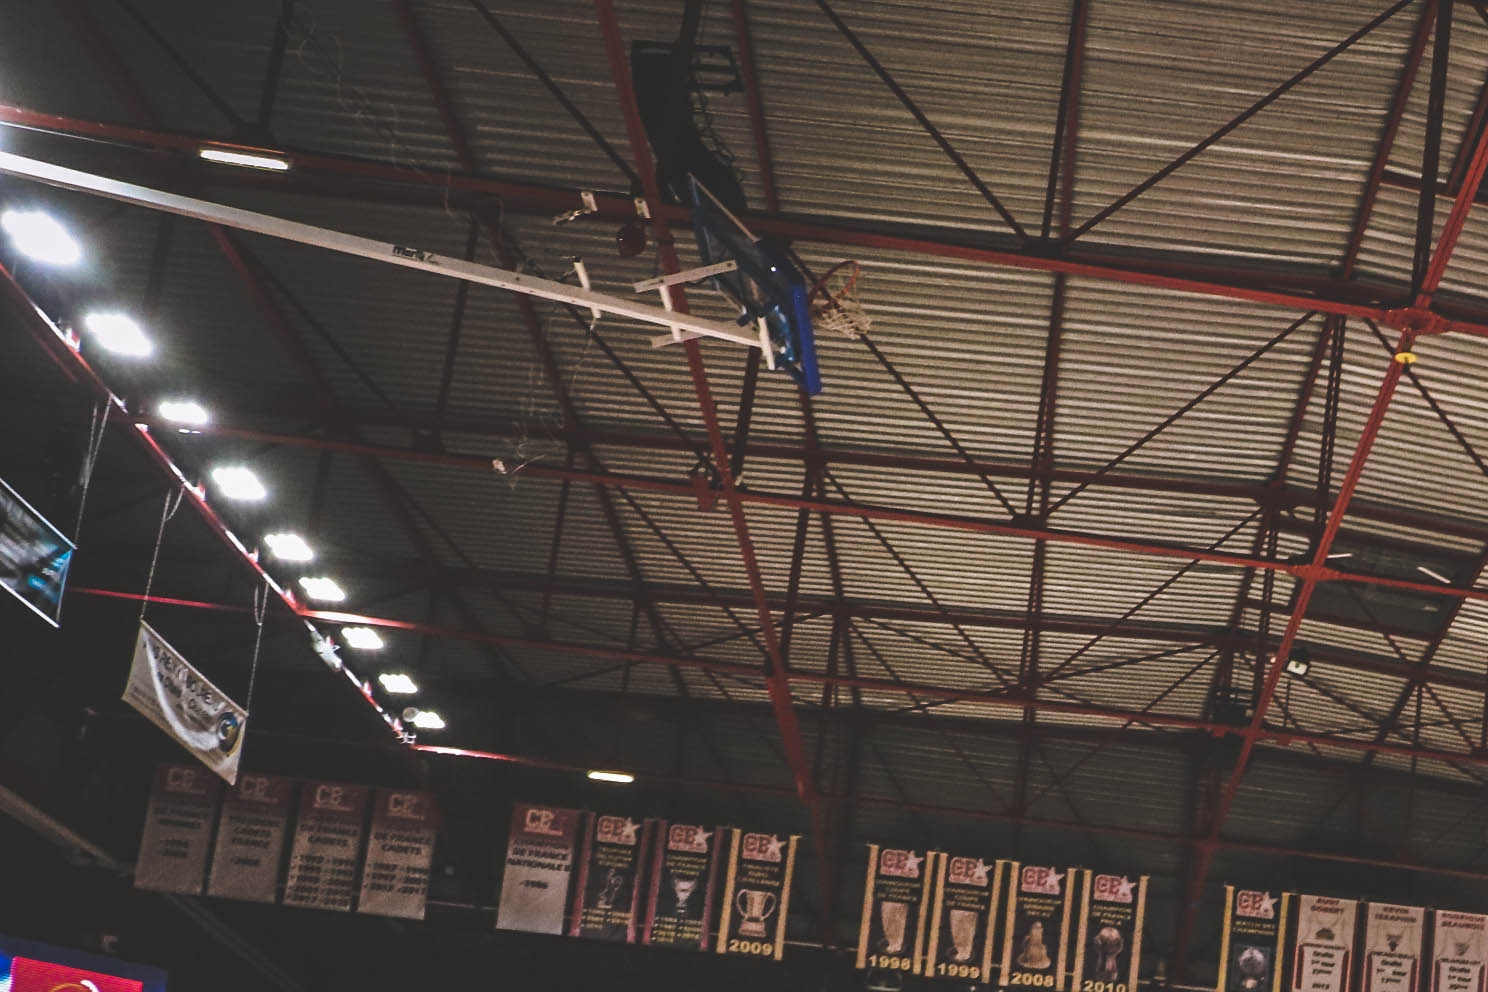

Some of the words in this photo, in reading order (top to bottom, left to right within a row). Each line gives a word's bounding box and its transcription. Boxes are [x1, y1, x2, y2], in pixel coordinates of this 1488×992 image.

[728, 938, 773, 957] 2009
[868, 954, 911, 970] 1998
[938, 962, 980, 979] 1999
[1011, 971, 1053, 988] 2008
